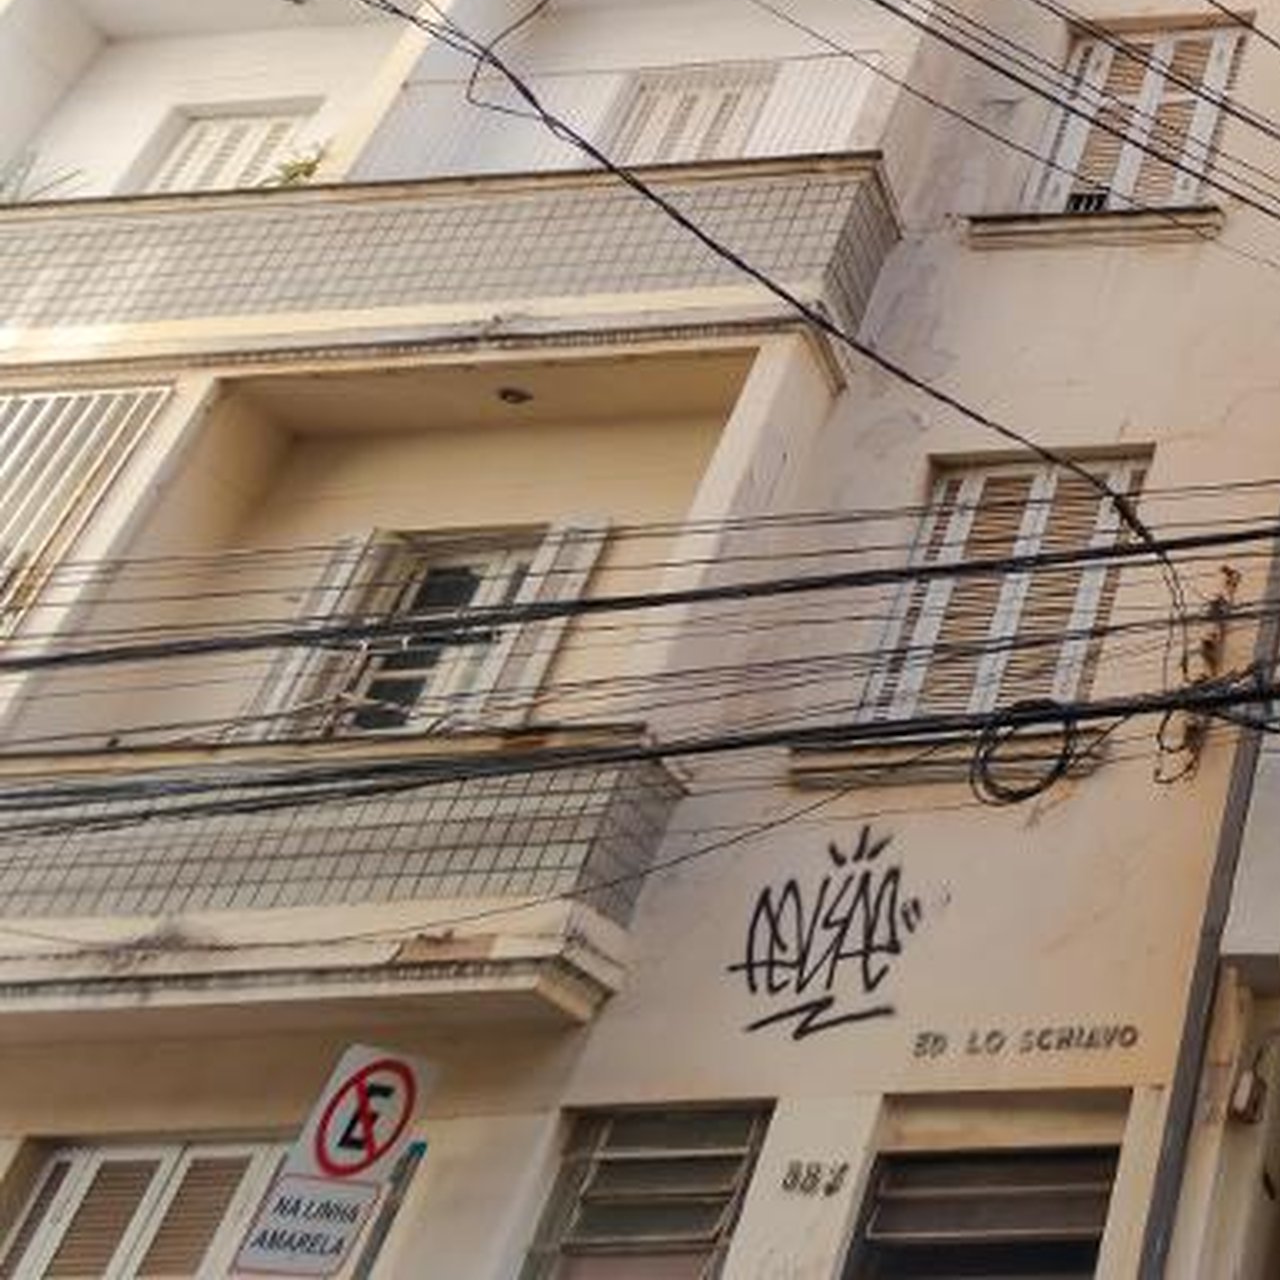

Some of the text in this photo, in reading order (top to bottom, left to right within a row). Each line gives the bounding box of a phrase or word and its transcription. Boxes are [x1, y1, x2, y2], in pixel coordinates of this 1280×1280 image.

[965, 1029, 1008, 1055] LO
[1018, 1024, 1140, 1055] SCHIAVO
[272, 1195, 301, 1218] NA
[250, 1228, 345, 1256] AMARELA
